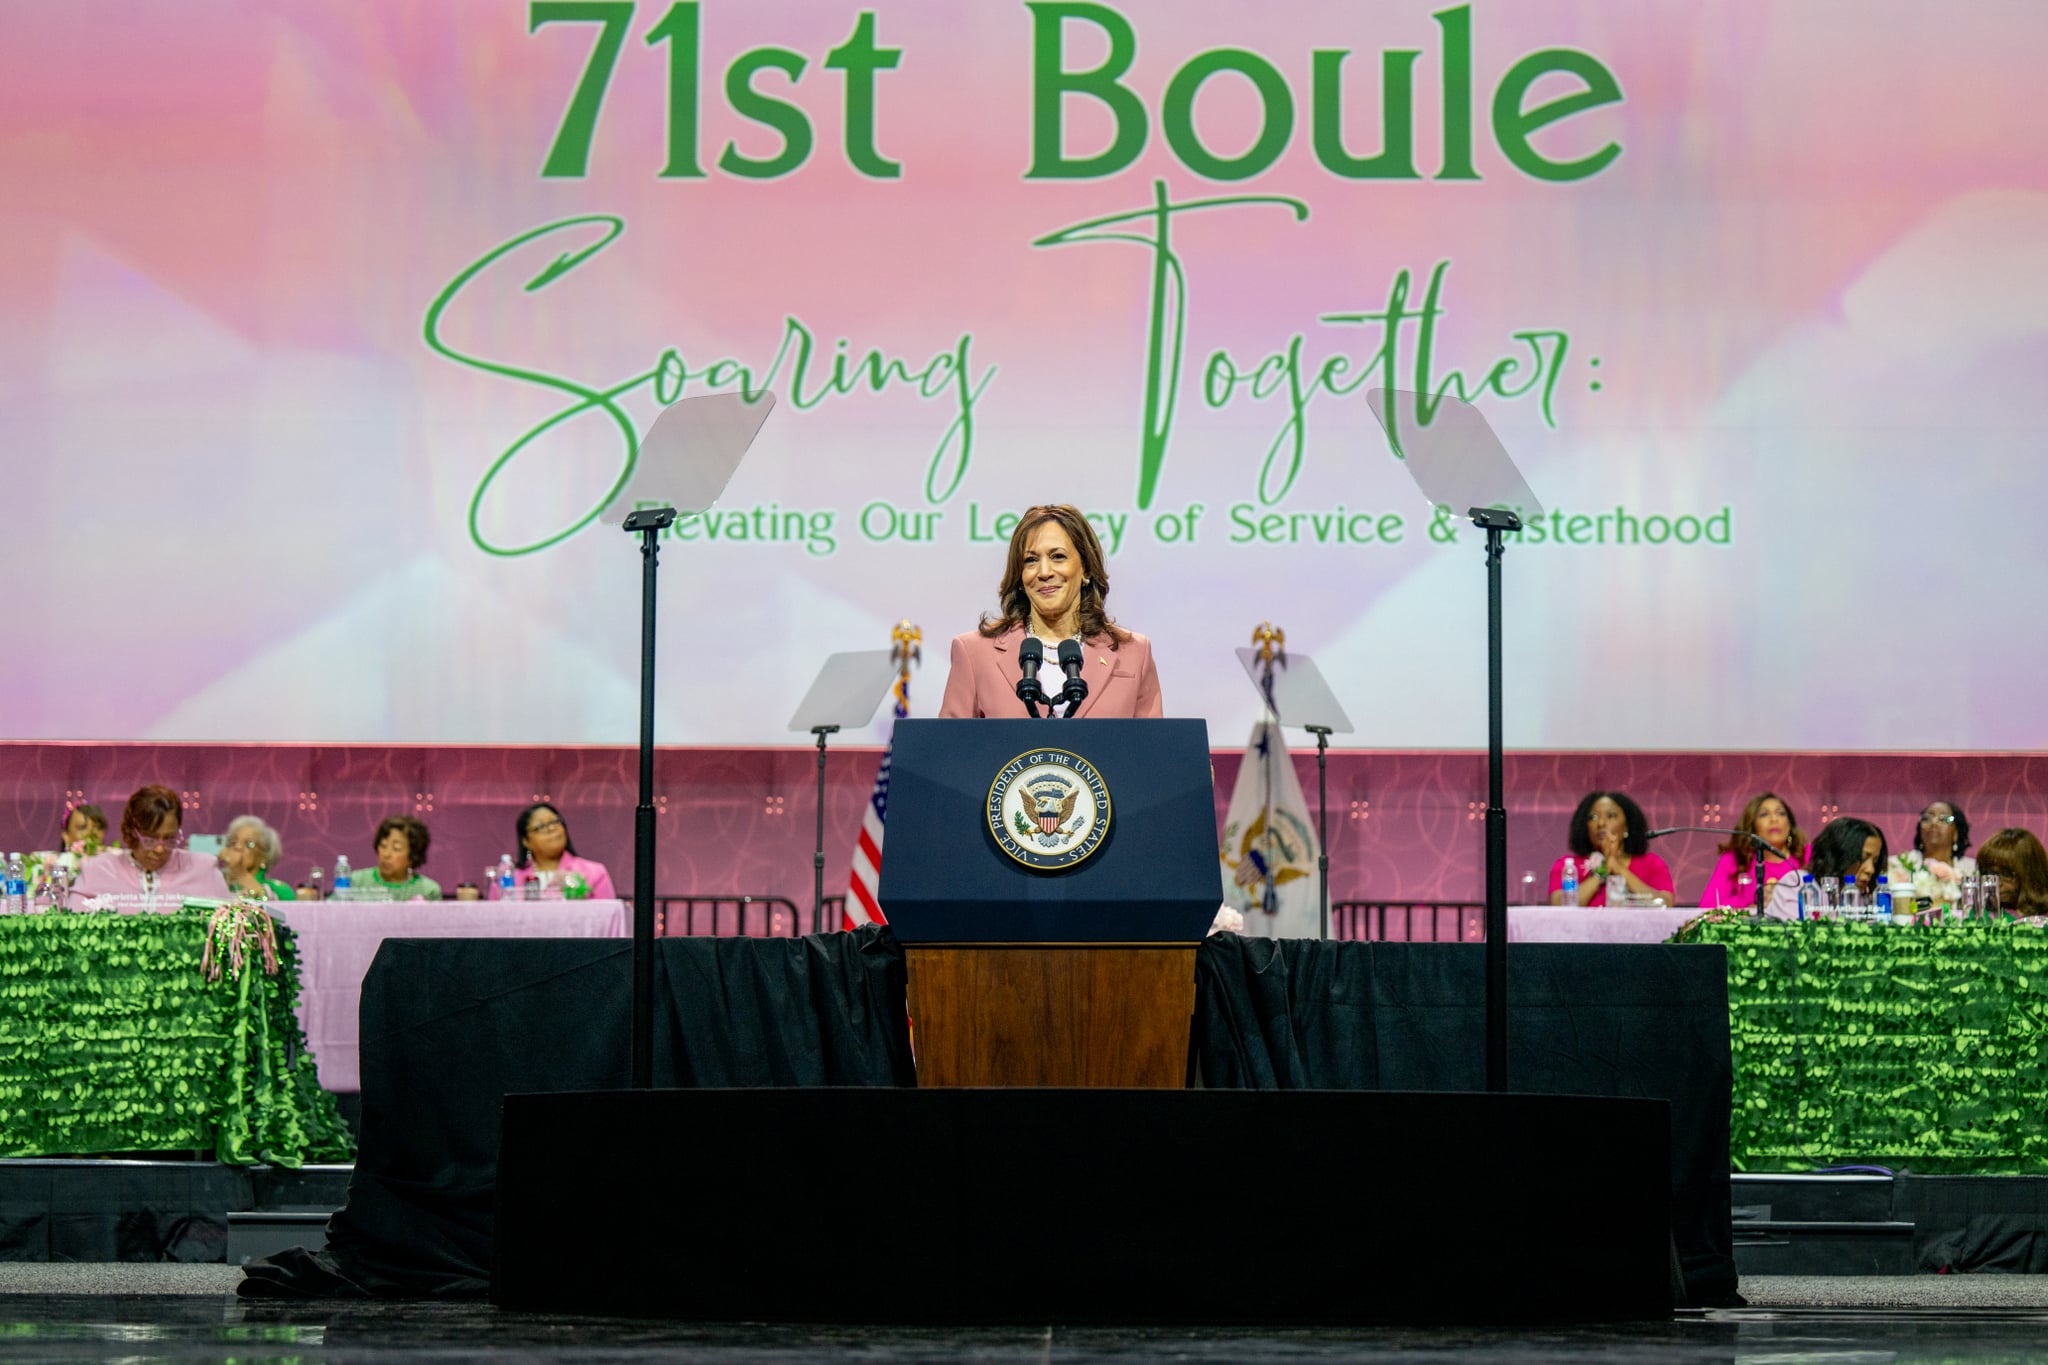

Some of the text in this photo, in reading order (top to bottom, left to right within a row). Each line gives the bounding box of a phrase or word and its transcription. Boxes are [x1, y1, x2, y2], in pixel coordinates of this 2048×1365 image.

[529, 2, 1624, 181] 71st Boule
[423, 180, 1602, 556] Soaring Together:
[860, 502, 943, 541] Our
[968, 502, 1128, 554] Lecy
[1154, 503, 1204, 542] of
[1230, 503, 1404, 544] Service
[1428, 504, 1459, 543] &
[990, 754, 1107, 861] VICE PRESIDENT OF THE UNITED STATES
